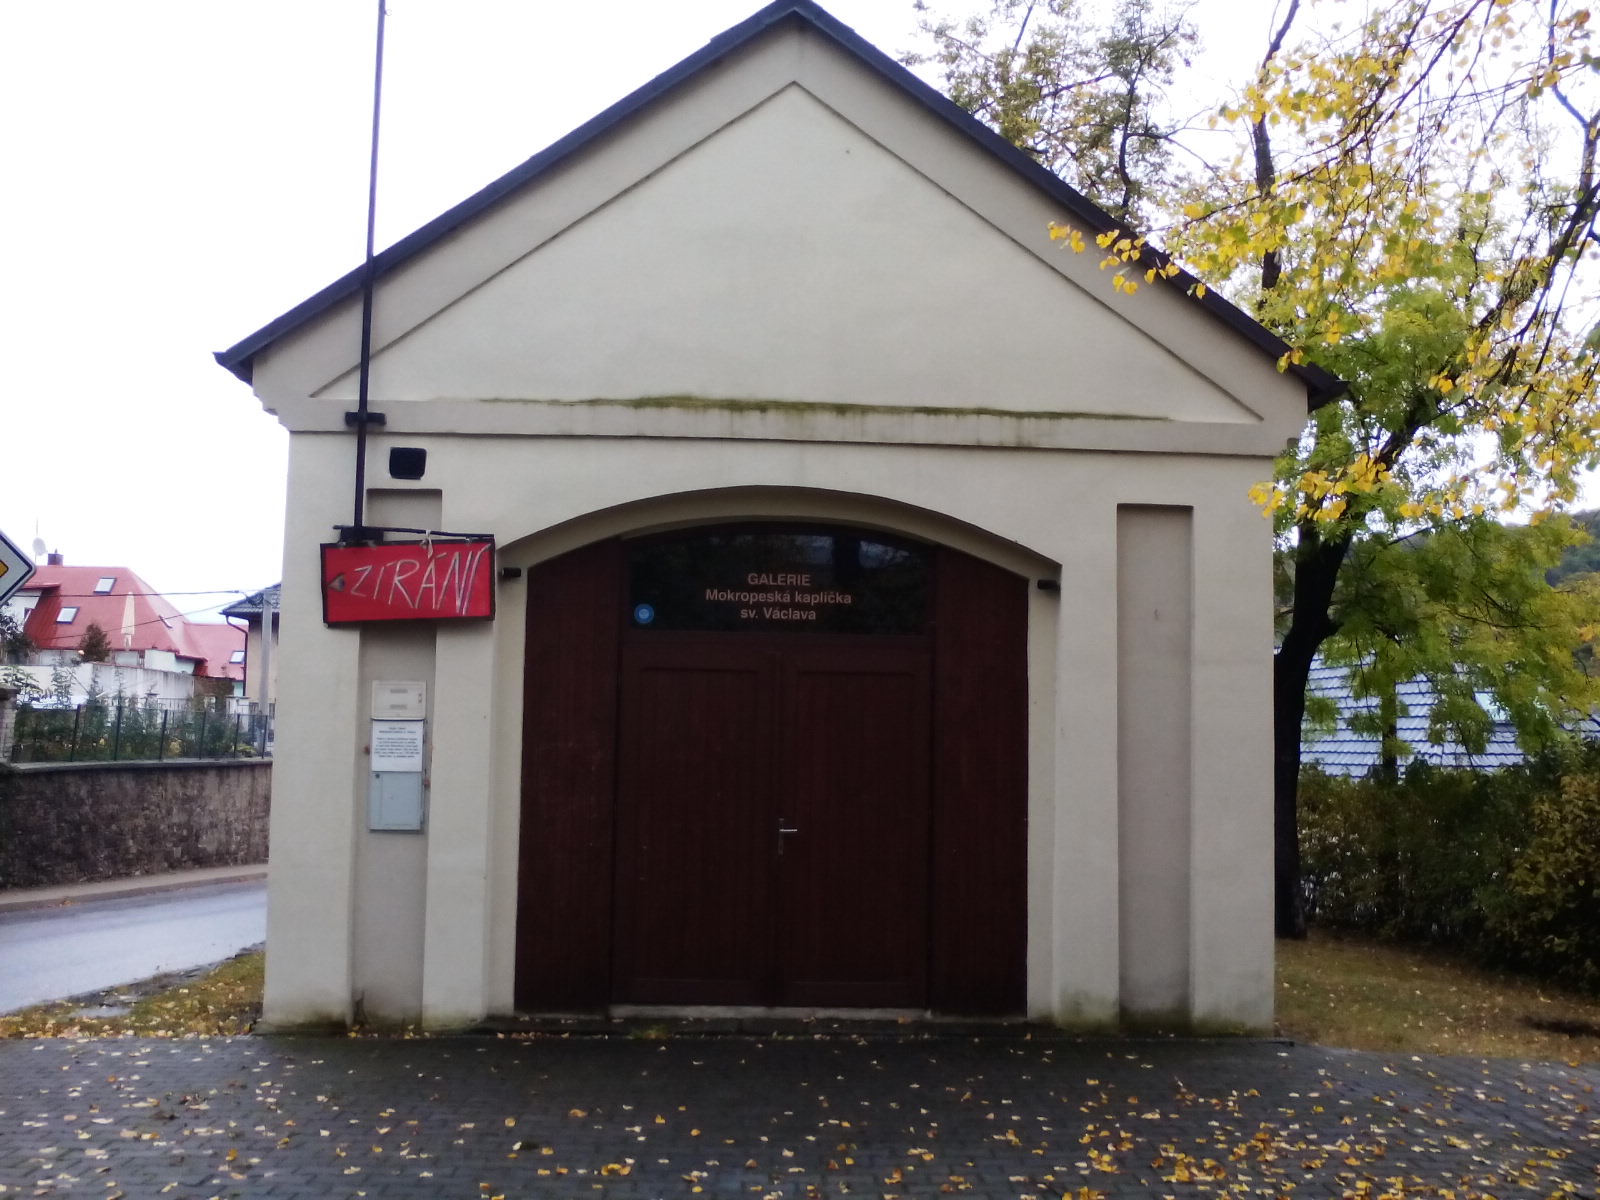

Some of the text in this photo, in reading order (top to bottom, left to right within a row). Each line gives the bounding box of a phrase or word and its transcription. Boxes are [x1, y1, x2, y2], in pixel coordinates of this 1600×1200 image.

[747, 572, 812, 586] GALERIE
[705, 588, 852, 606] Mokropeská kaplička
[740, 606, 817, 620] sv. Václava
